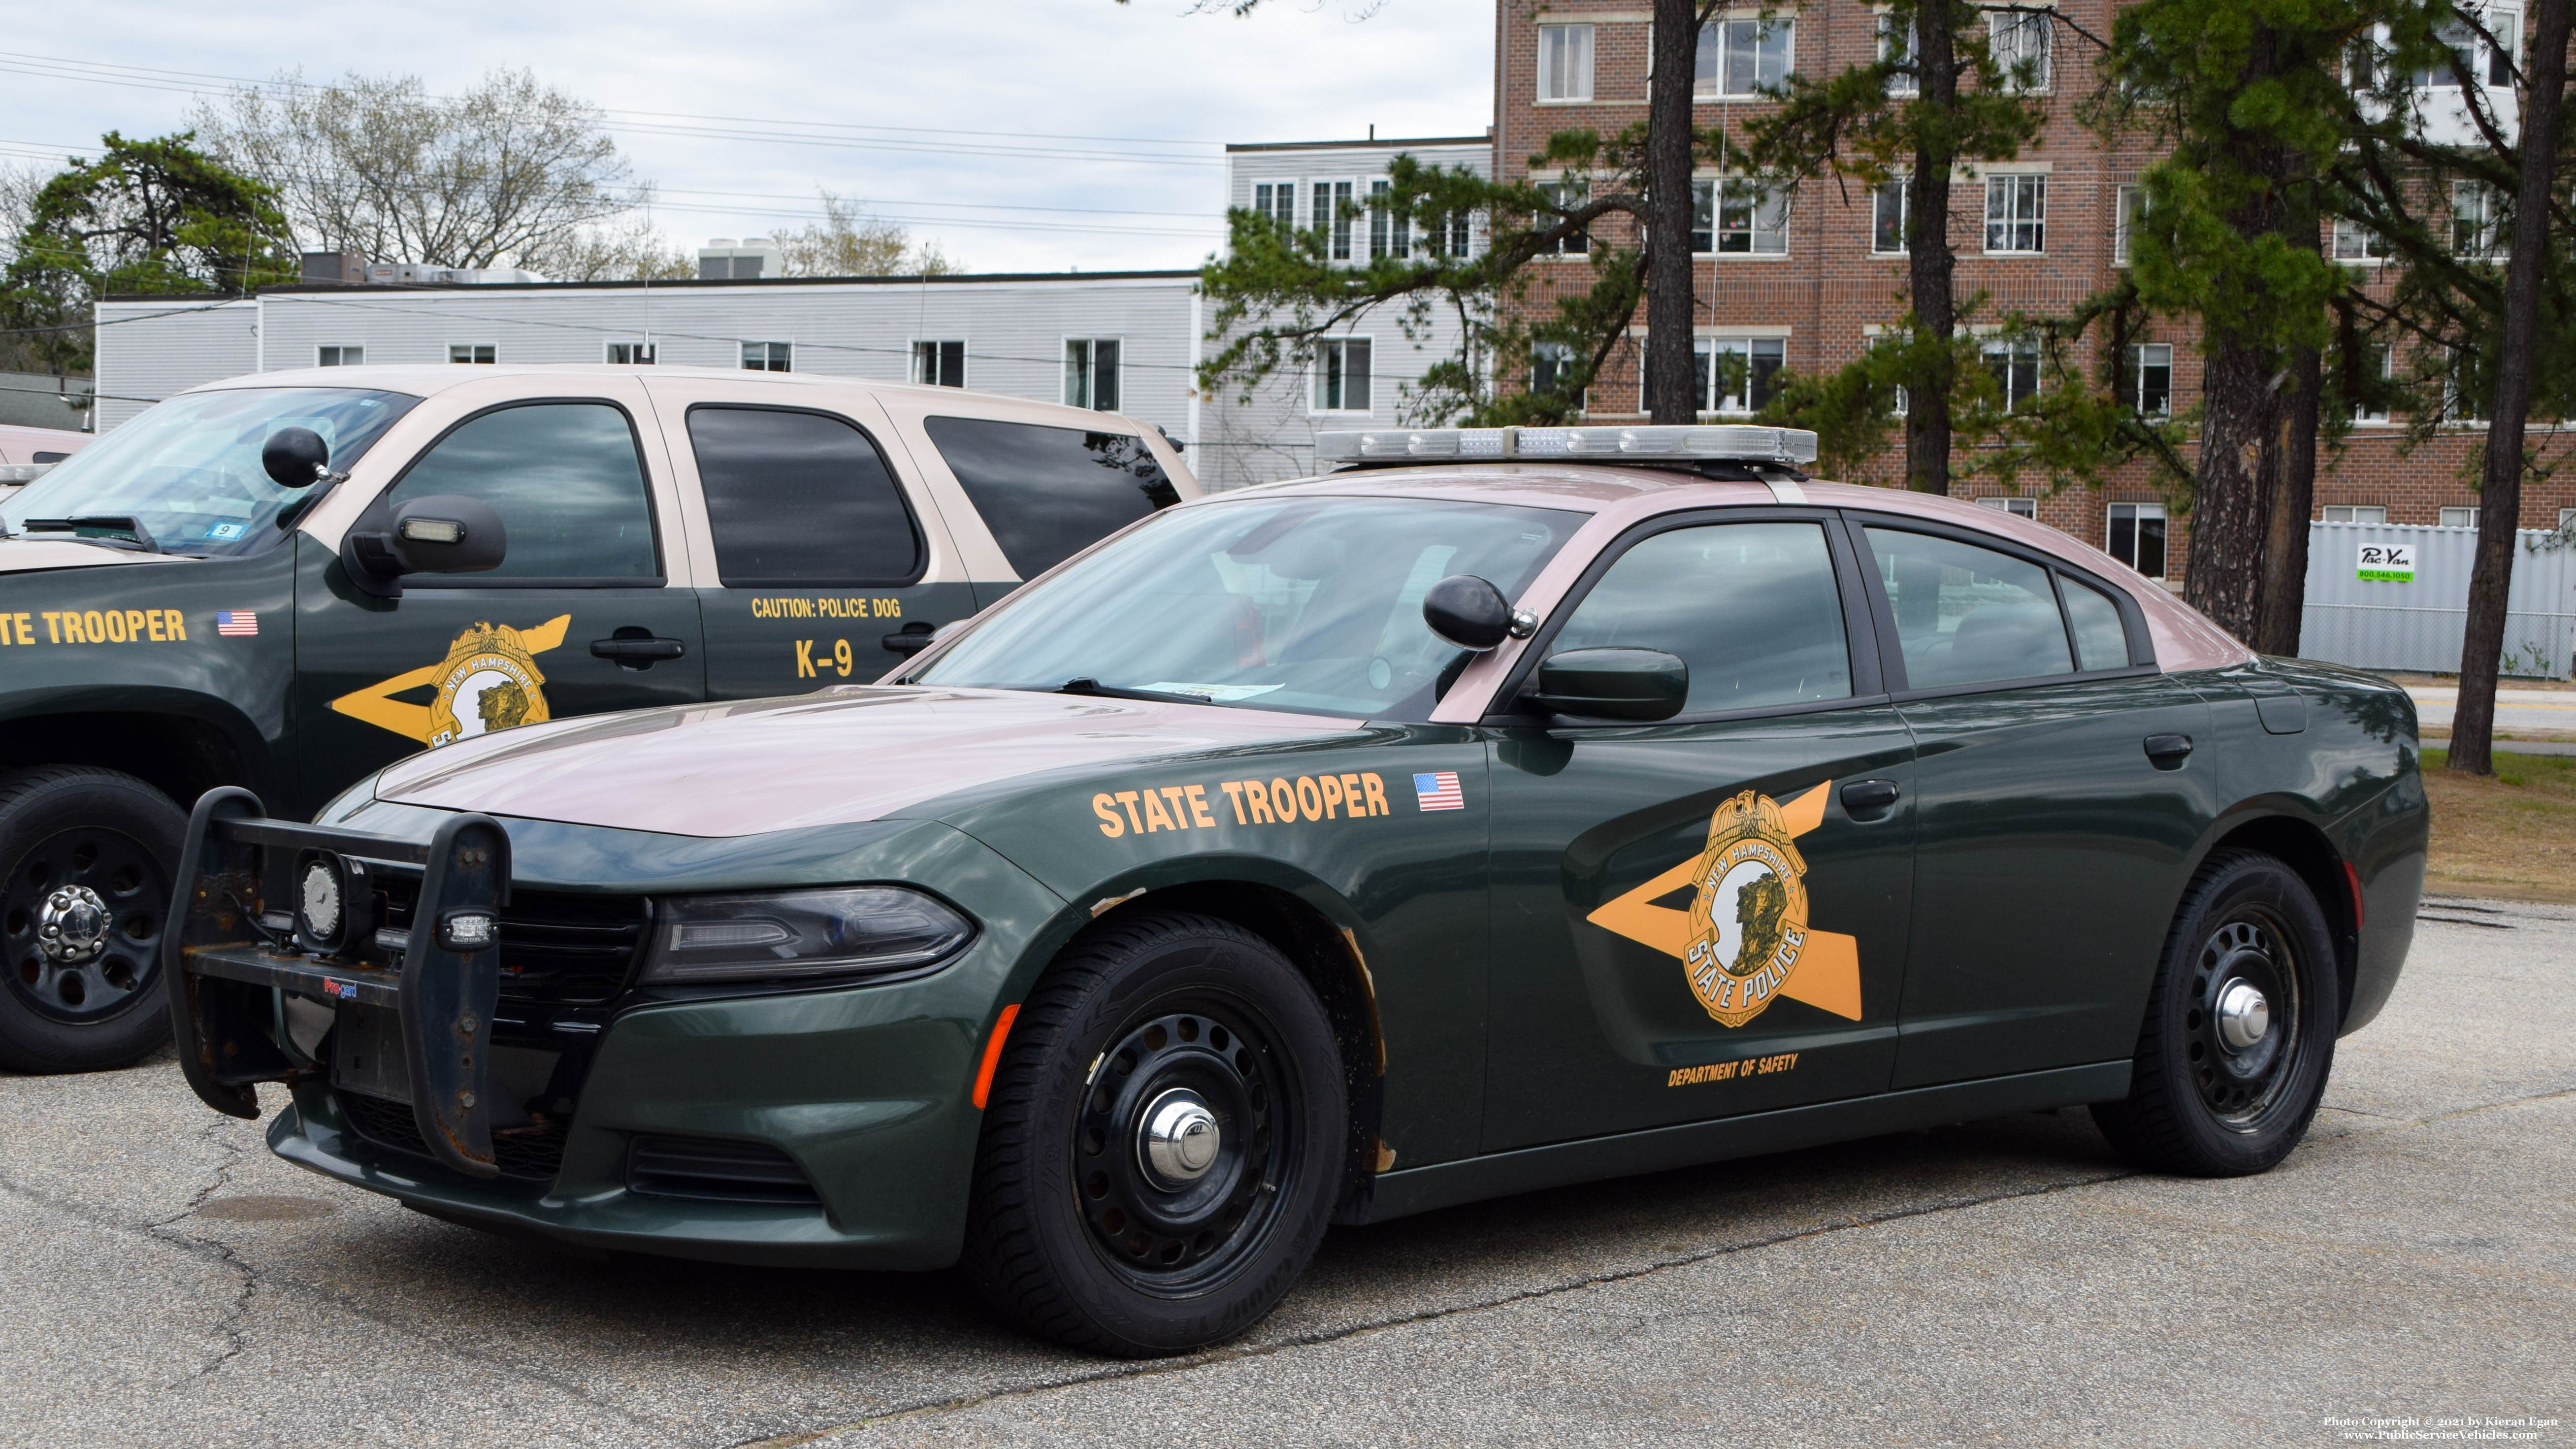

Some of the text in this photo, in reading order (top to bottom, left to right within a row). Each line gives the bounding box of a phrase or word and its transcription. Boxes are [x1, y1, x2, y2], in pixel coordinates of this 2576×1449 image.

[219, 526, 230, 535] 9
[2362, 547, 2410, 565] Pac-Van
[2359, 570, 2410, 579] 800.546.1050
[751, 598, 901, 618] CAUTION: POLICE DOG
[42, 609, 187, 644] TROOPER
[446, 658, 532, 691] NEW HAMPSHIRE
[796, 639, 852, 678] K-9
[1092, 772, 1390, 838] STATE TROOPER
[1706, 843, 1793, 889] NEW HAMPSHIRE
[1688, 927, 1806, 1008] STATE POLICE
[1668, 1053, 1798, 1087] DEPARTMENT OF SAFETY
